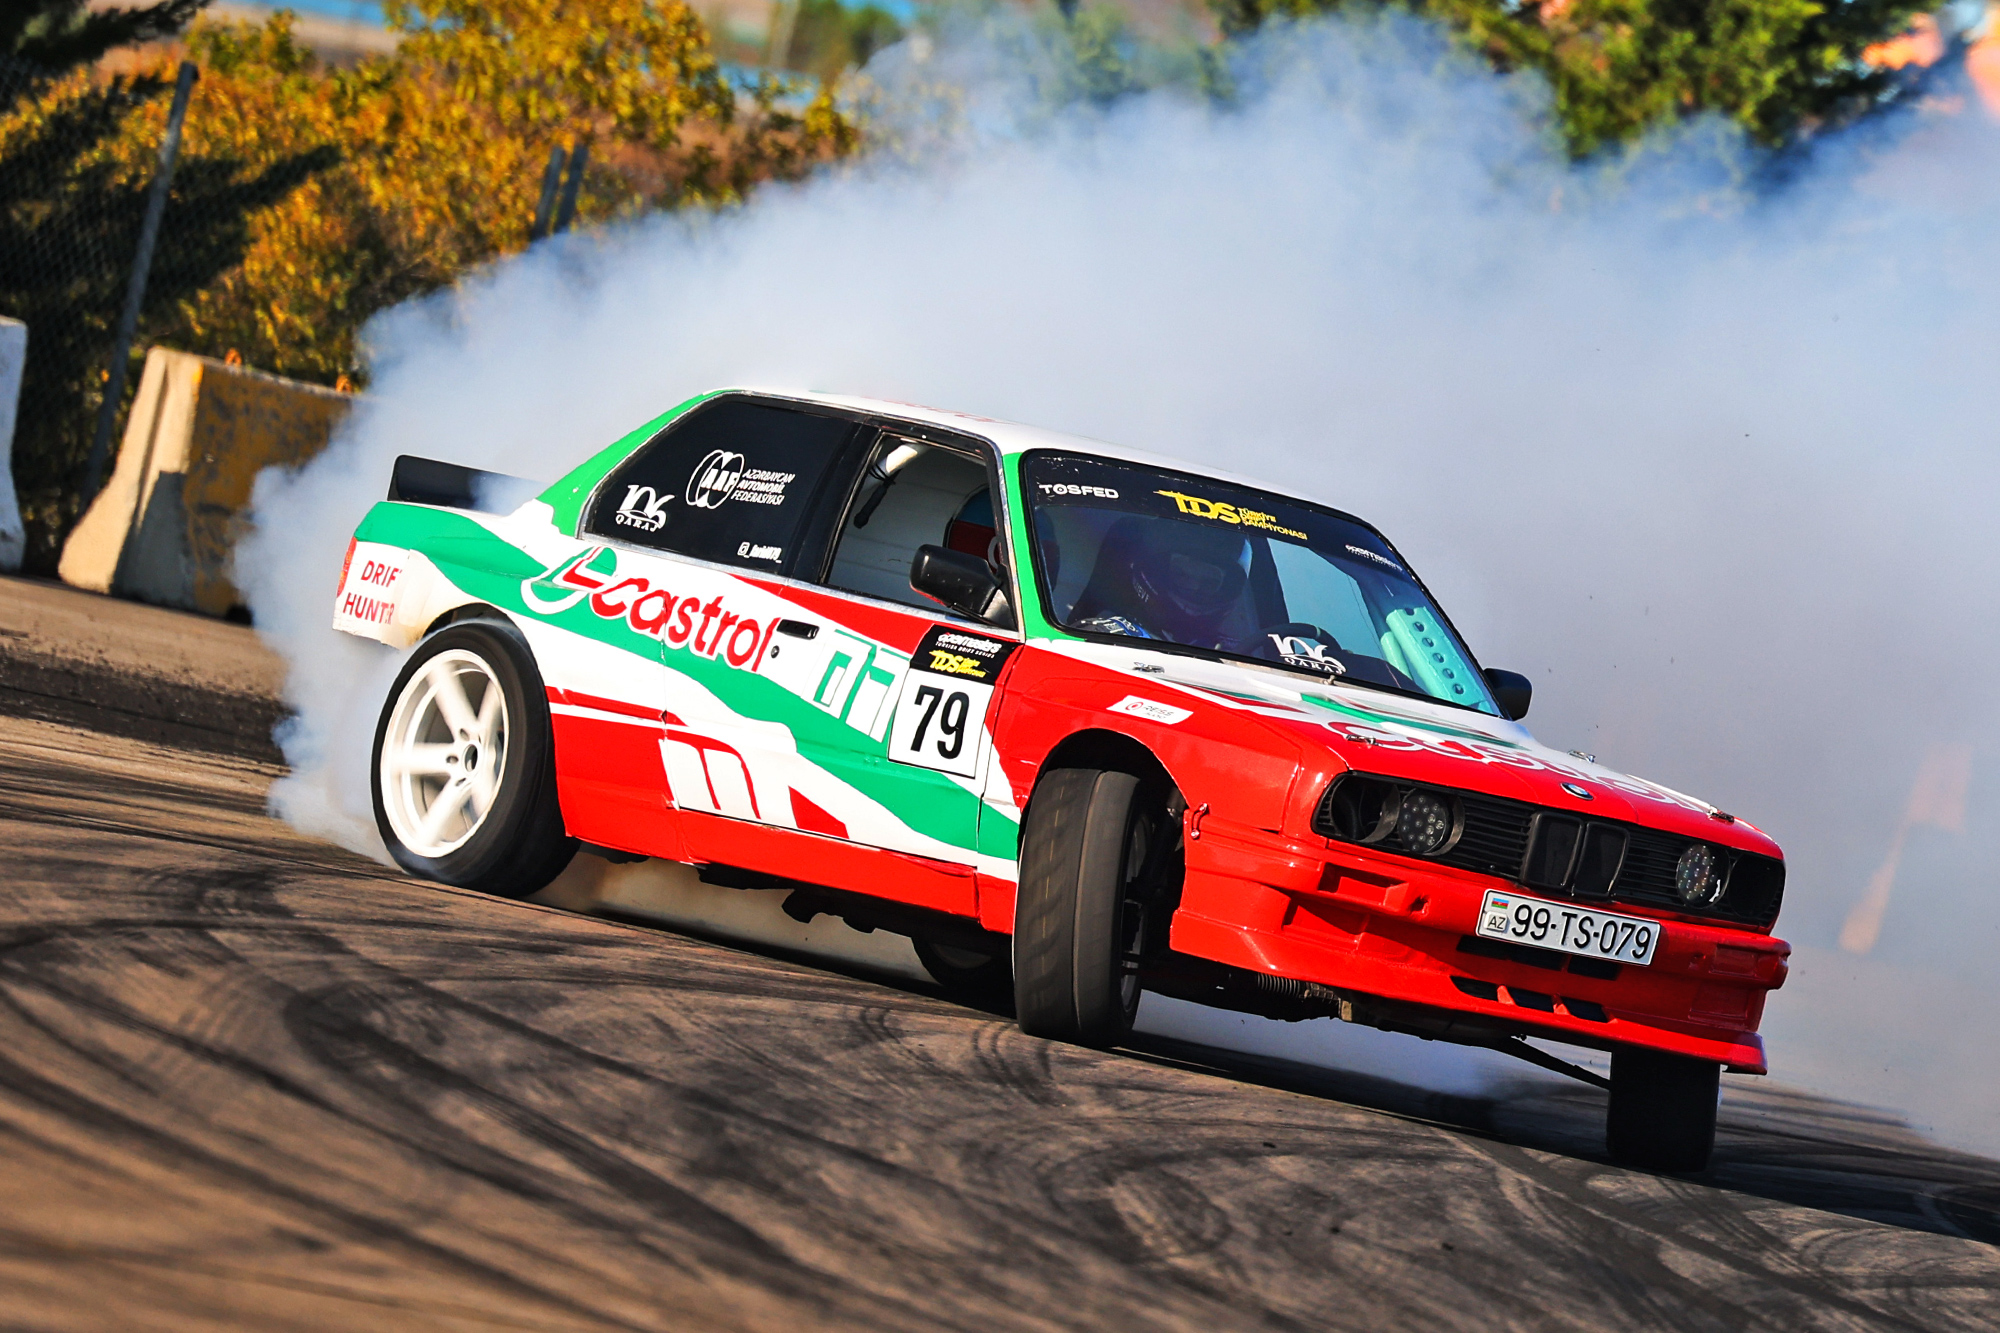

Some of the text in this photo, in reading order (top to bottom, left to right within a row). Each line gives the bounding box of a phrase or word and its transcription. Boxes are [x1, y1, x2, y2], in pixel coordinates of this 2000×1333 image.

[1038, 483, 1120, 499] TOSFED
[1153, 489, 1242, 524] TDS
[615, 513, 659, 533] QARAJ
[360, 560, 402, 588] DRIF
[342, 592, 395, 625] HUNTR
[591, 577, 782, 673] Castrol
[909, 684, 970, 760] 79
[1487, 915, 1507, 930] AZ
[1510, 903, 1652, 960] 99-TS-079
